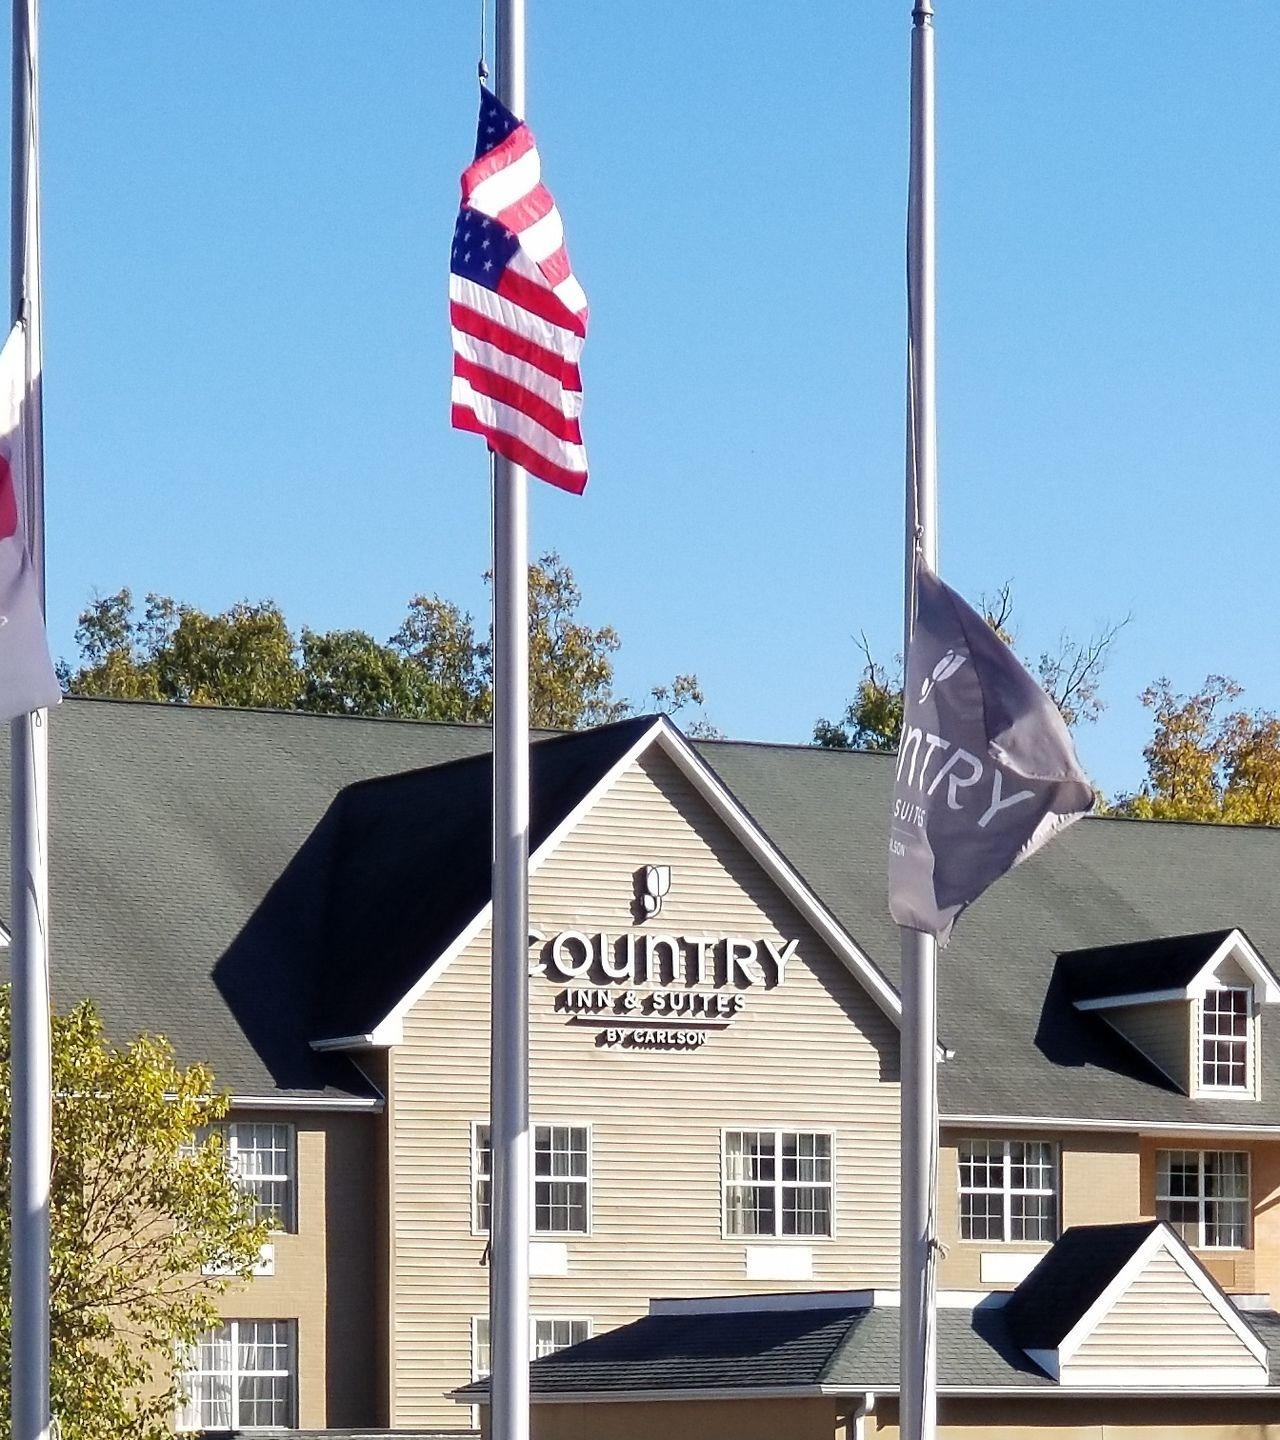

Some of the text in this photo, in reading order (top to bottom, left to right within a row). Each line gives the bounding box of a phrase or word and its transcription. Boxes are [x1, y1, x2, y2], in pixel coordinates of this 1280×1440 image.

[566, 988, 746, 1012] INN & SUITES
[607, 1028, 709, 1046] BY CARLSON
